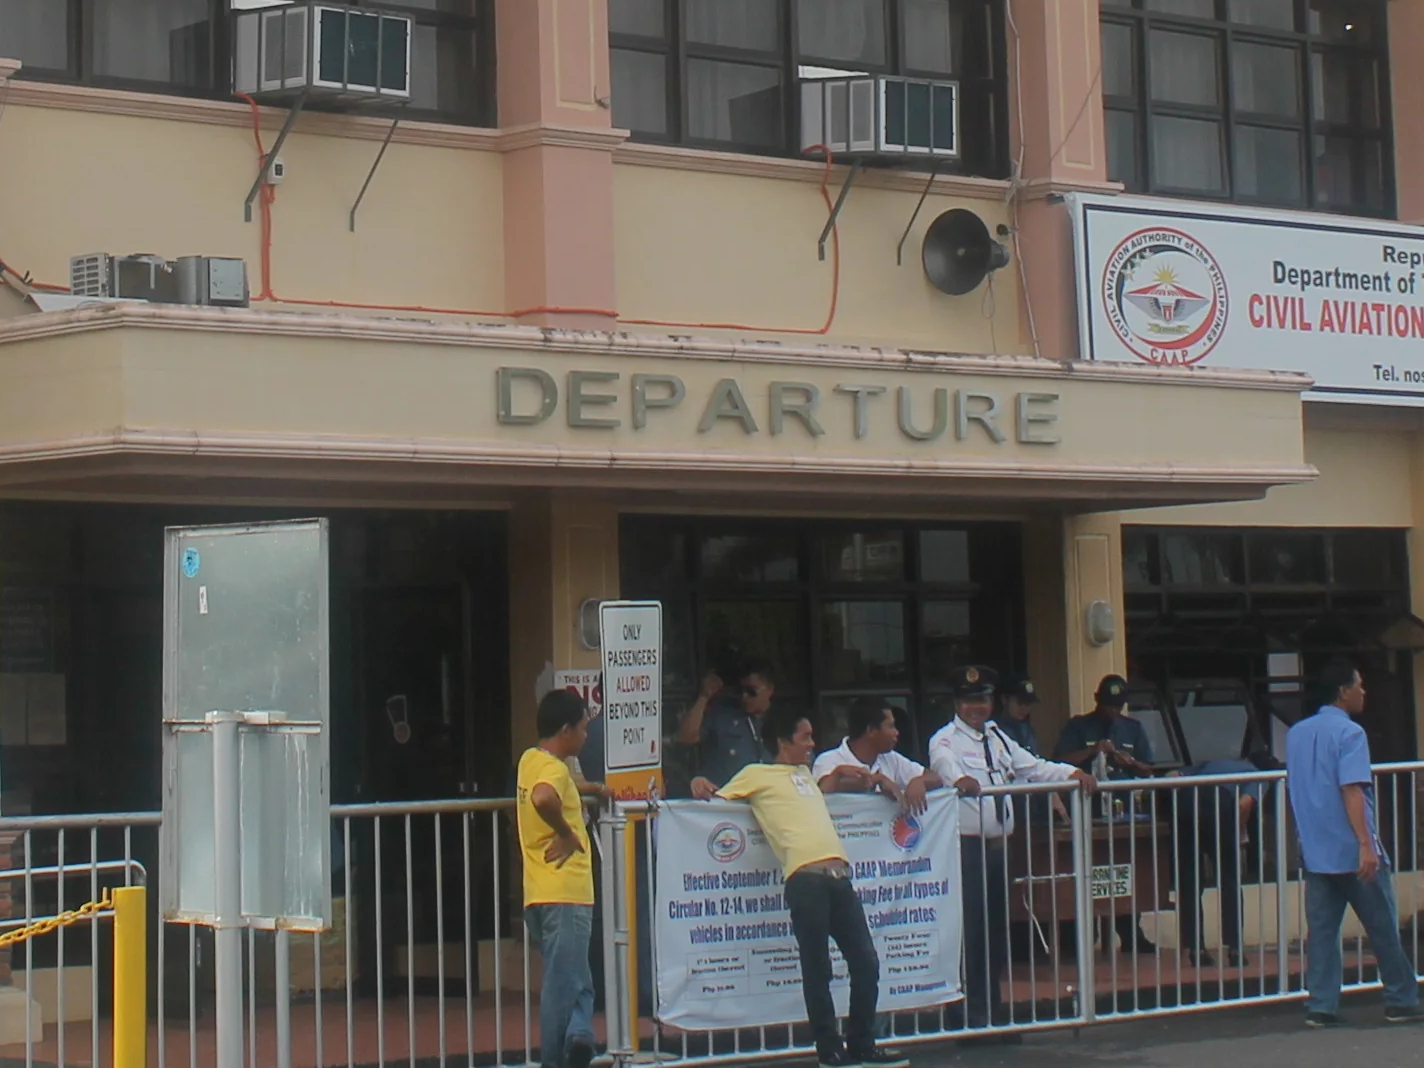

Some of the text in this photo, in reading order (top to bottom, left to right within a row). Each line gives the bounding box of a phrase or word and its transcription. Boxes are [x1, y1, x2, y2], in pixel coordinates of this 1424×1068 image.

[1130, 232, 1183, 251] AUTHORITY
[1104, 245, 1130, 303] AVIATION
[1272, 260, 1391, 292] Department
[1397, 272, 1416, 294] of
[1248, 293, 1312, 331] CIVIL
[1109, 305, 1129, 342] CIVIL
[1149, 348, 1189, 364] CAAP
[1372, 363, 1399, 382] Tel.
[496, 366, 1062, 445] DEPARTURE
[622, 623, 642, 641] ONLY
[607, 648, 657, 667] PASSENGERS
[563, 675, 580, 684] THIS
[582, 675, 590, 683] IS
[616, 675, 651, 692] ALLOWED
[609, 703, 639, 720] BEYOND
[641, 699, 657, 718] THIS
[622, 727, 645, 745] POINT
[683, 872, 720, 892] Effective
[721, 869, 771, 890] September
[855, 860, 878, 880] CAAP
[878, 885, 893, 902] Fee
[914, 880, 941, 900] types
[669, 898, 703, 920] Circular
[704, 897, 718, 916] No.
[746, 897, 758, 913] we
[760, 893, 782, 912] shall
[689, 924, 724, 944] vehicles
[725, 923, 734, 941] in
[736, 920, 788, 940] accordance
